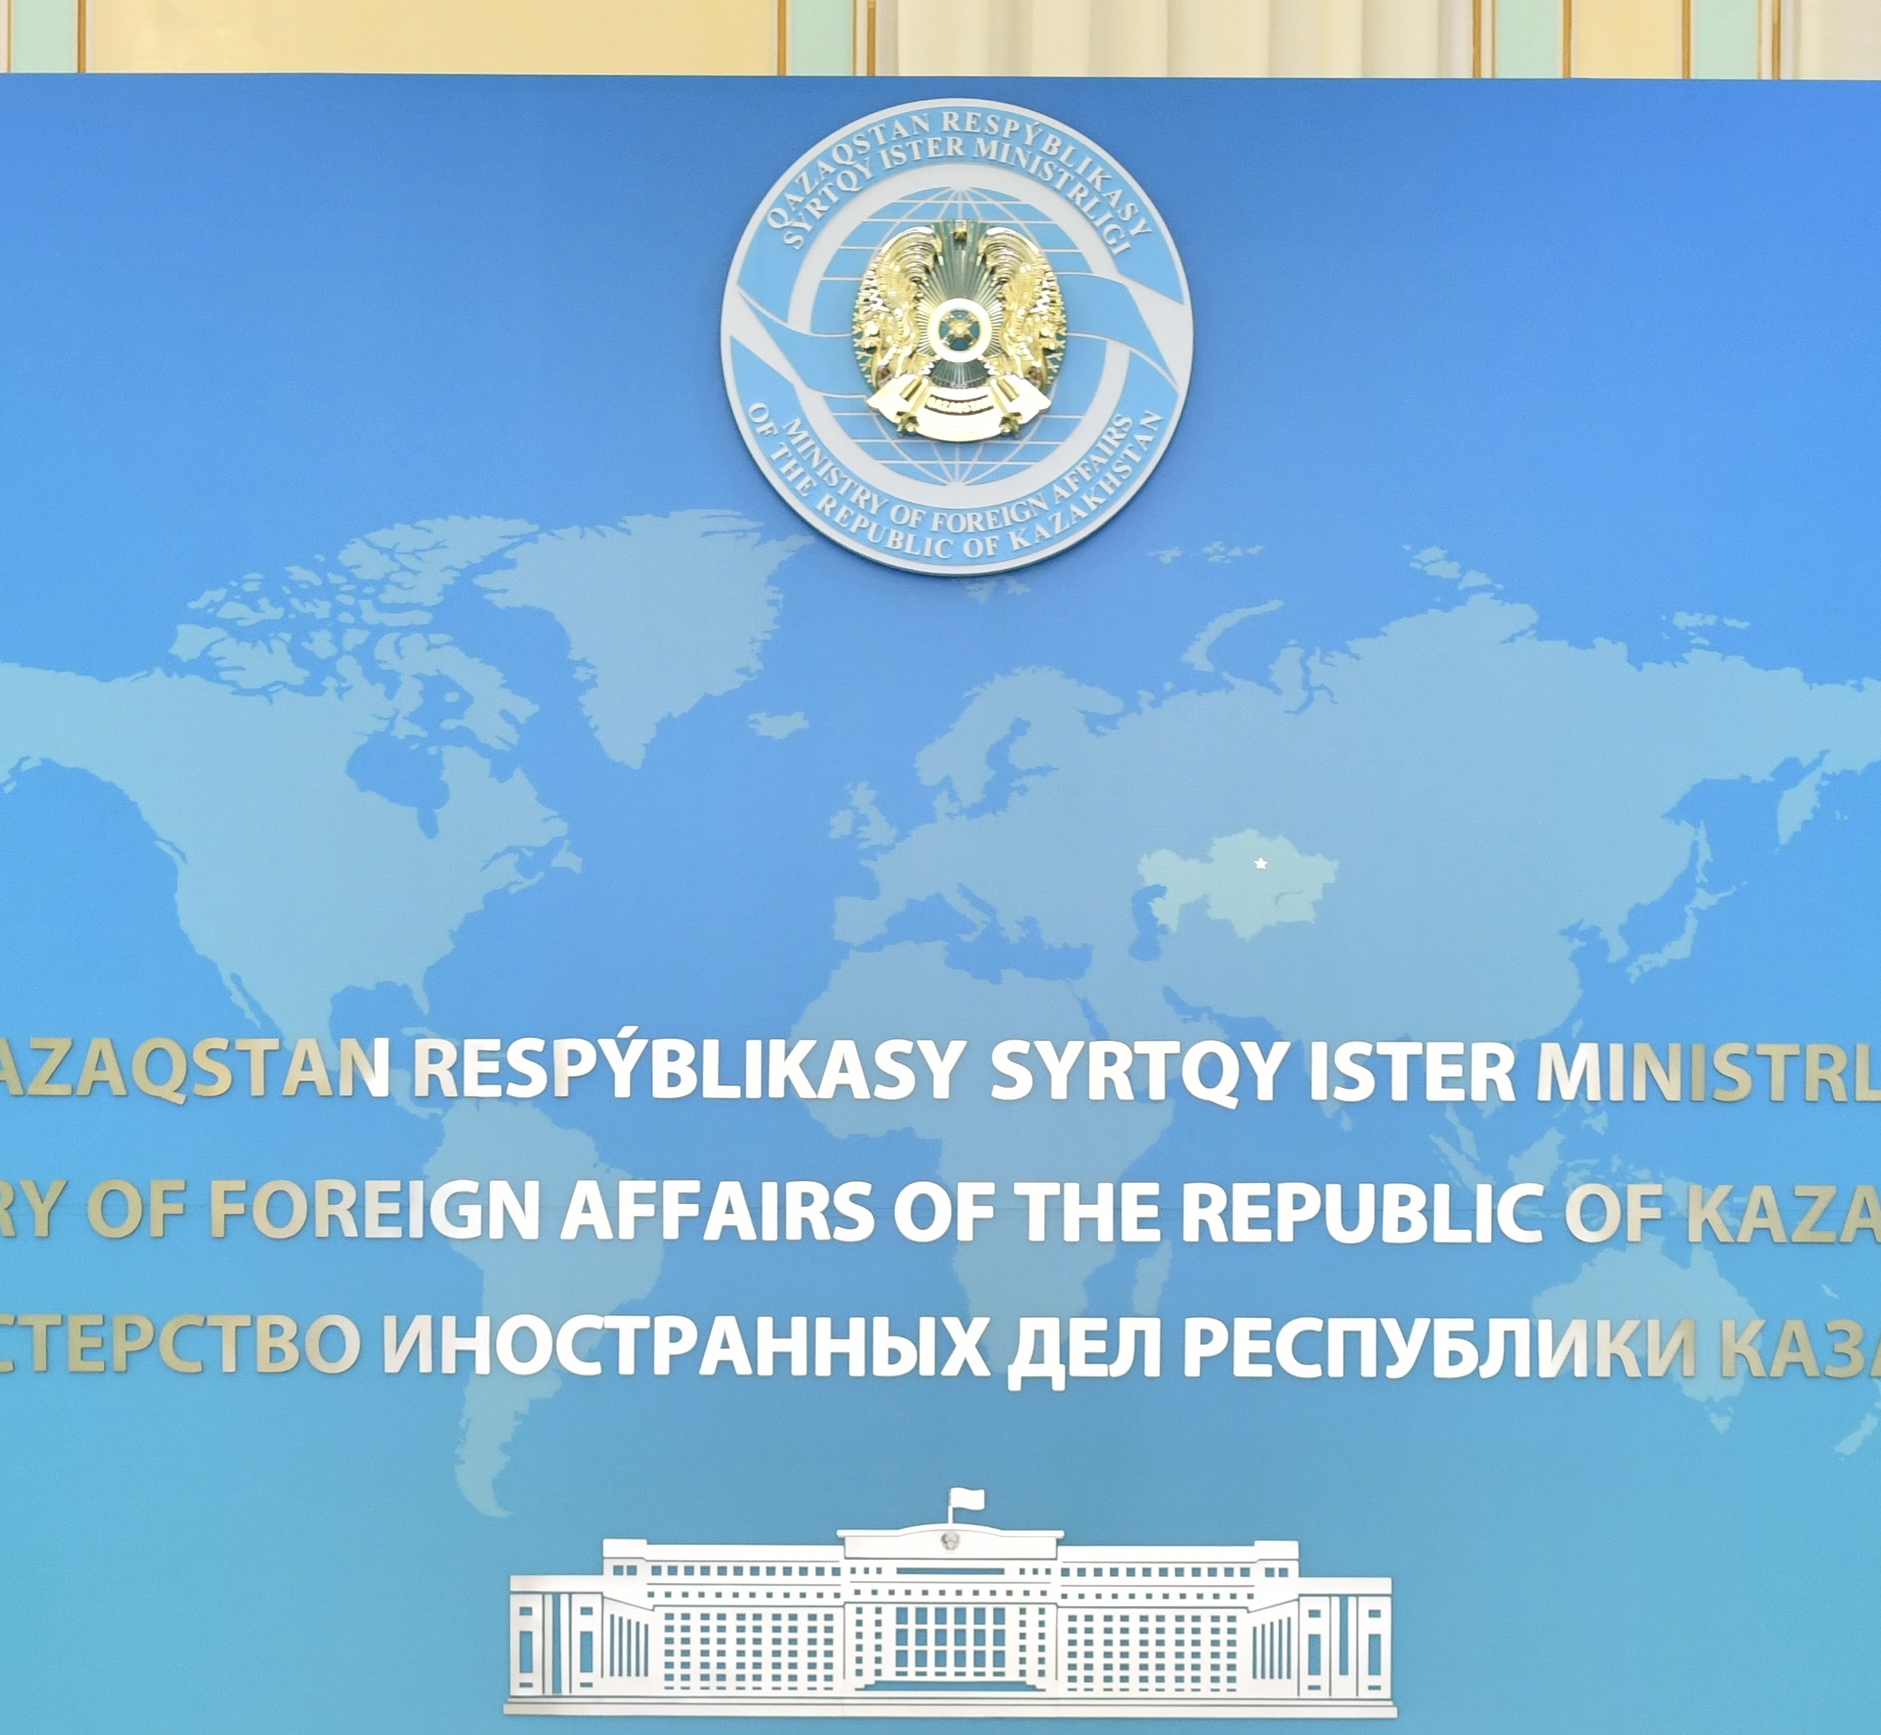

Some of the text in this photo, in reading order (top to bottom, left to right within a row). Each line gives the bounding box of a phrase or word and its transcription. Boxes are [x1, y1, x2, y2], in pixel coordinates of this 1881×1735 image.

[767, 111, 1153, 238] QAZAQSTAN RESPÝBLIKASY
[783, 137, 1131, 256] SYRTQY ISTER MINISTRLIGI
[748, 401, 1164, 560] OF THE REPUBLIC OF KAZAKHSTAN
[781, 412, 1134, 533] MINISTRY OF FOREIGN AFFAIRS
[415, 1025, 968, 1101] RESPÝBLIKASY
[990, 1039, 1291, 1110] SYRTQY
[1312, 1041, 1515, 1103] ISTER
[87, 1179, 186, 1239] OF
[210, 1179, 540, 1241] FOREIGN
[560, 1179, 876, 1242] AFFAIRS
[894, 1181, 995, 1243] OF
[1013, 1182, 1162, 1244] THE
[1183, 1182, 1546, 1245] REPUBLIC
[1565, 1183, 1665, 1245] OF
[383, 1313, 991, 1377] ИНОСТРАННЫХ
[1007, 1316, 1162, 1392] ДЕЛ
[1184, 1317, 1698, 1379] РЕСПУБЛИКИ
